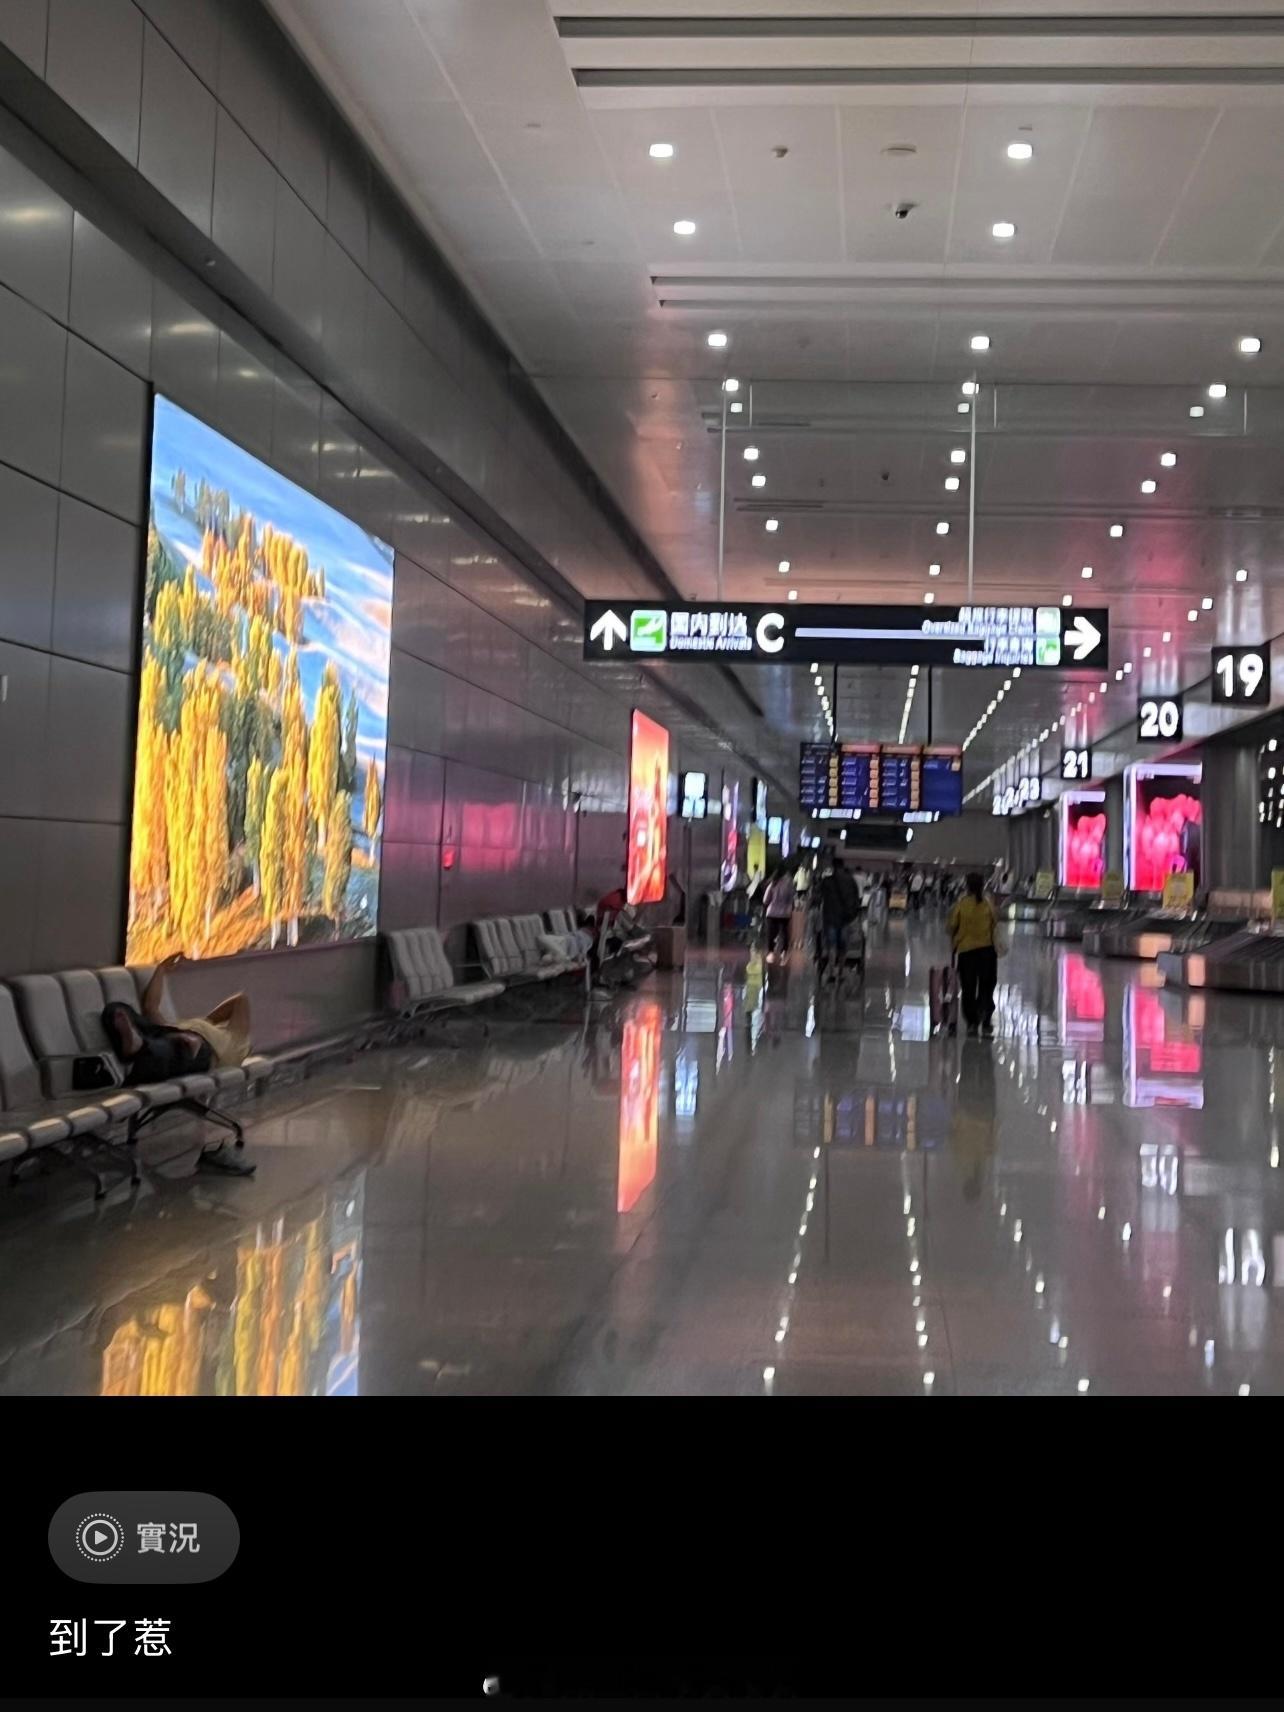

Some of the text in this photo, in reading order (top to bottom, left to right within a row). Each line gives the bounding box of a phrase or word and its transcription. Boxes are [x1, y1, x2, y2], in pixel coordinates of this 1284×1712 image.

[756, 612, 785, 653] C
[1216, 653, 1264, 698] 19
[1140, 701, 1179, 737] 20
[1064, 751, 1087, 777] 21
